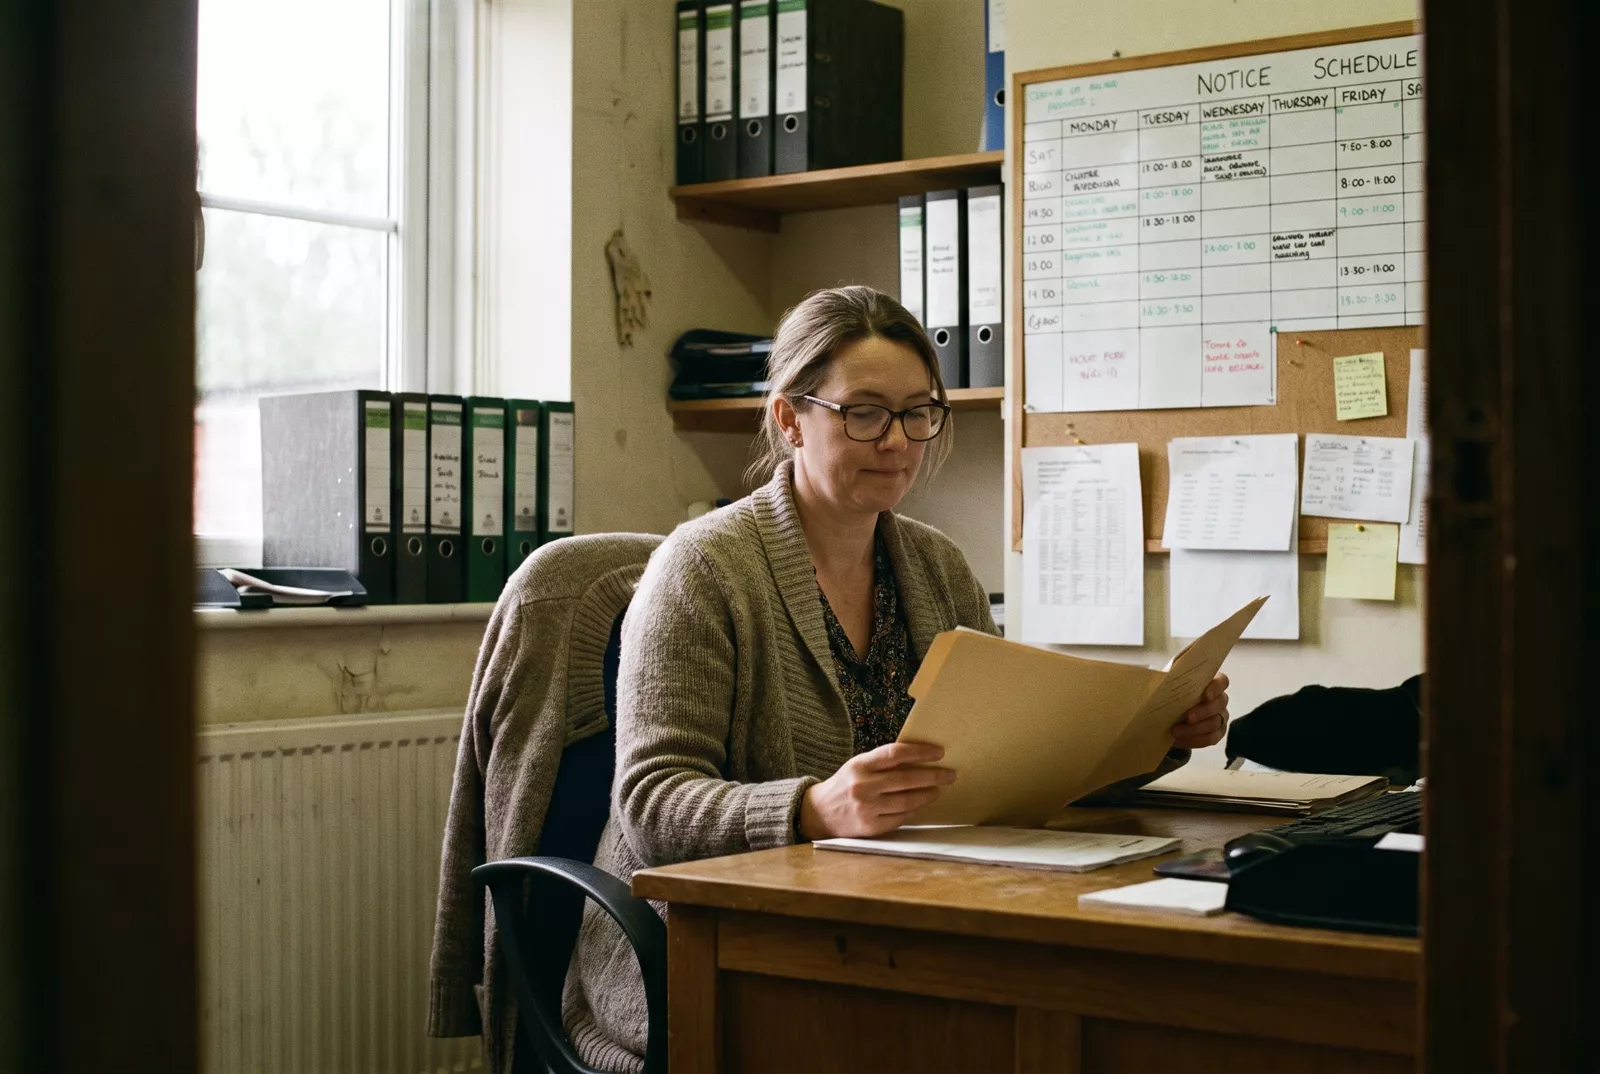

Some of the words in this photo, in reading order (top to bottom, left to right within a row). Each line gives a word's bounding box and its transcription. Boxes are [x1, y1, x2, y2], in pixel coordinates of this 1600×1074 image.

[1197, 66, 1271, 96] NOTICE
[1313, 50, 1419, 80] SCHEDULE
[1272, 95, 1329, 111] THURSDAY
[1342, 88, 1386, 102] FRIDAY
[1142, 110, 1190, 125] TUESDAY
[1203, 102, 1266, 119] WEDNESDAY
[1070, 118, 1118, 134] MONDAY
[1029, 149, 1055, 165] SAT
